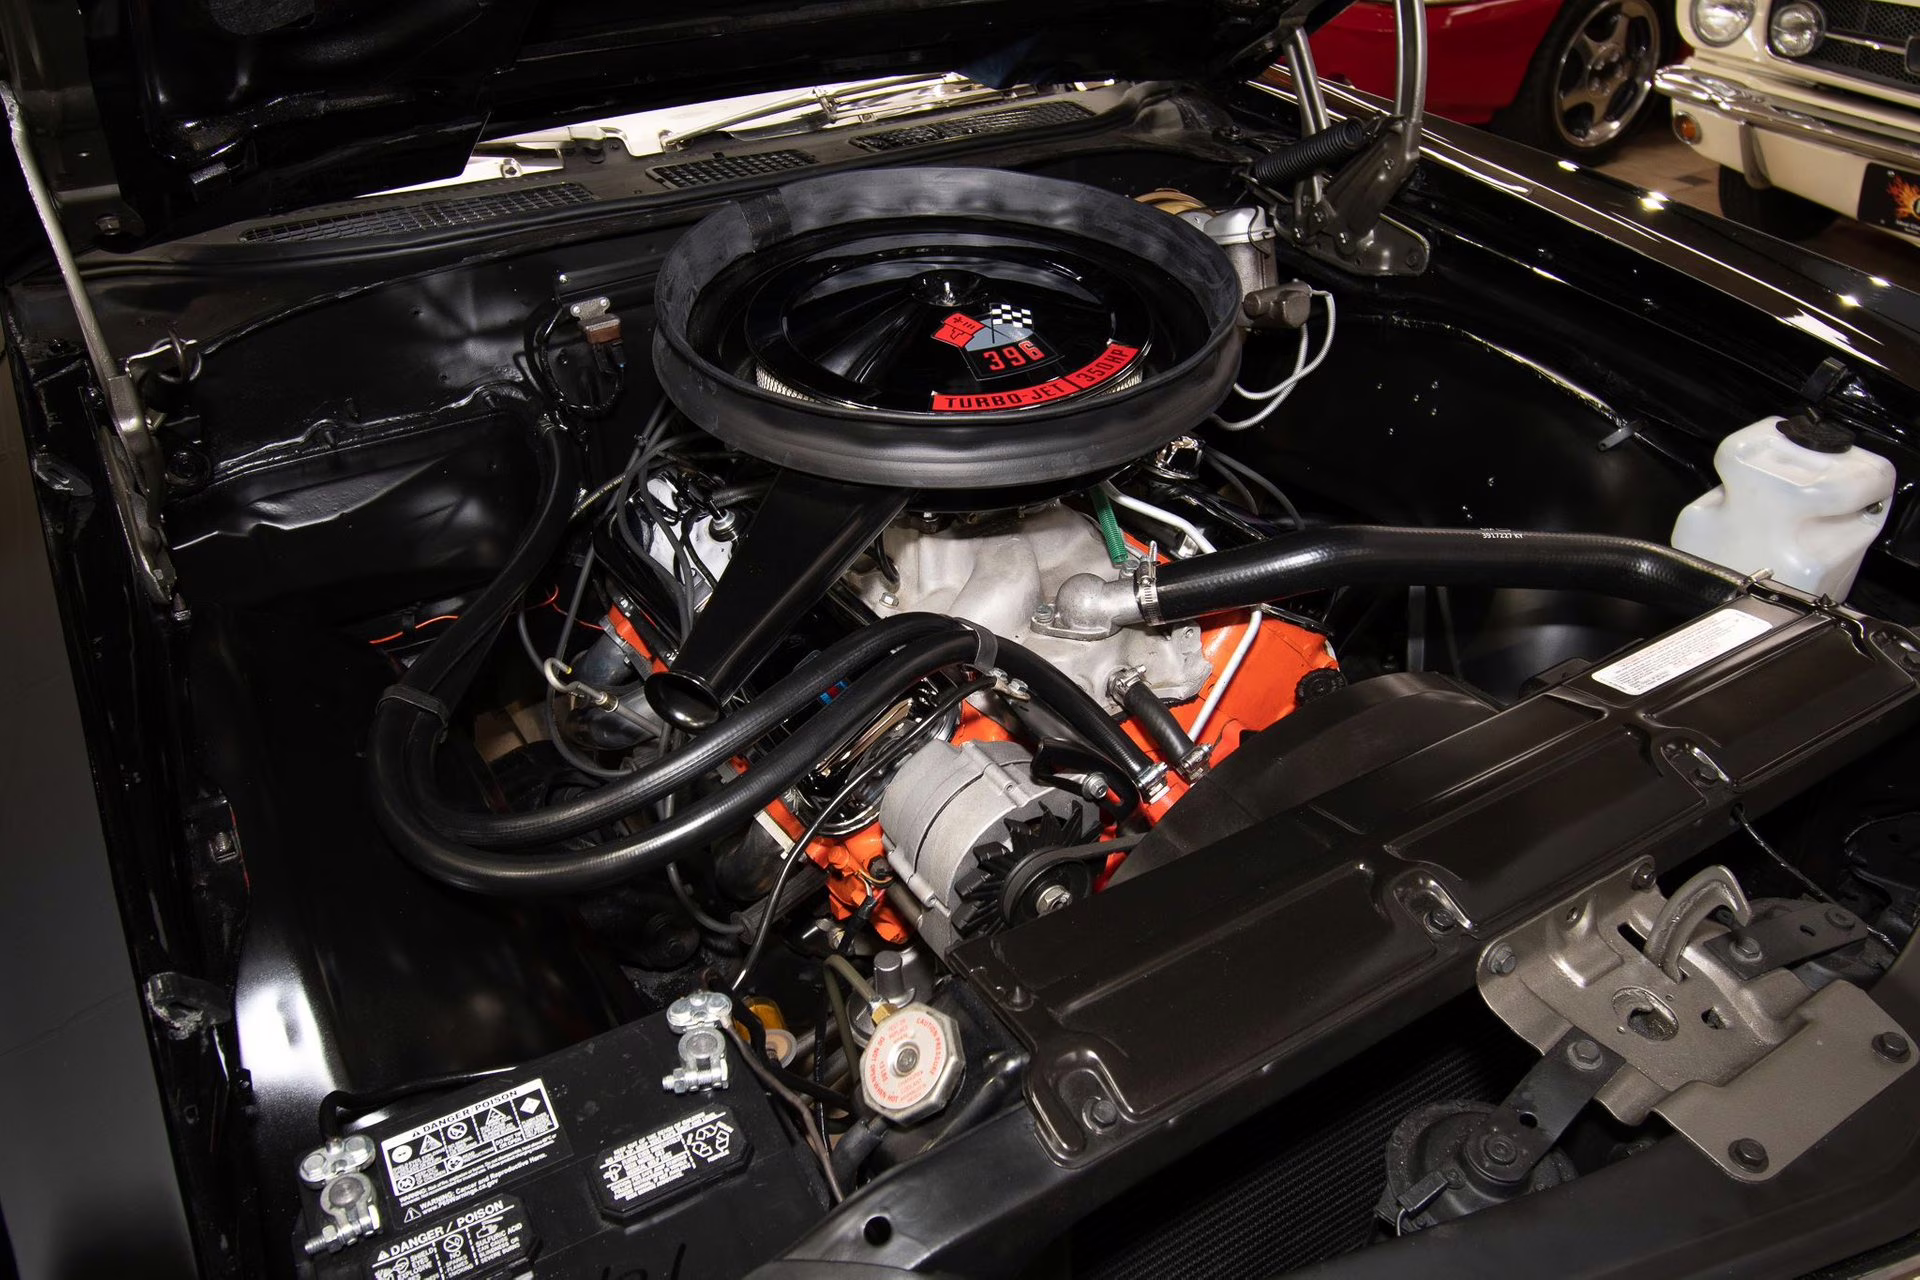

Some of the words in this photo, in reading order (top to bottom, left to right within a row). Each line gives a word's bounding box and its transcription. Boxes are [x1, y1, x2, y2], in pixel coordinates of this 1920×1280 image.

[983, 340, 1045, 372] 396
[944, 383, 1066, 409] TURBO-JET
[422, 1108, 470, 1133] DANGER
[475, 1090, 518, 1111] POISON
[390, 1226, 444, 1256] DANGER
[457, 1200, 504, 1228] POISON
[507, 1223, 523, 1235] ACID
[449, 1250, 461, 1260] NO
